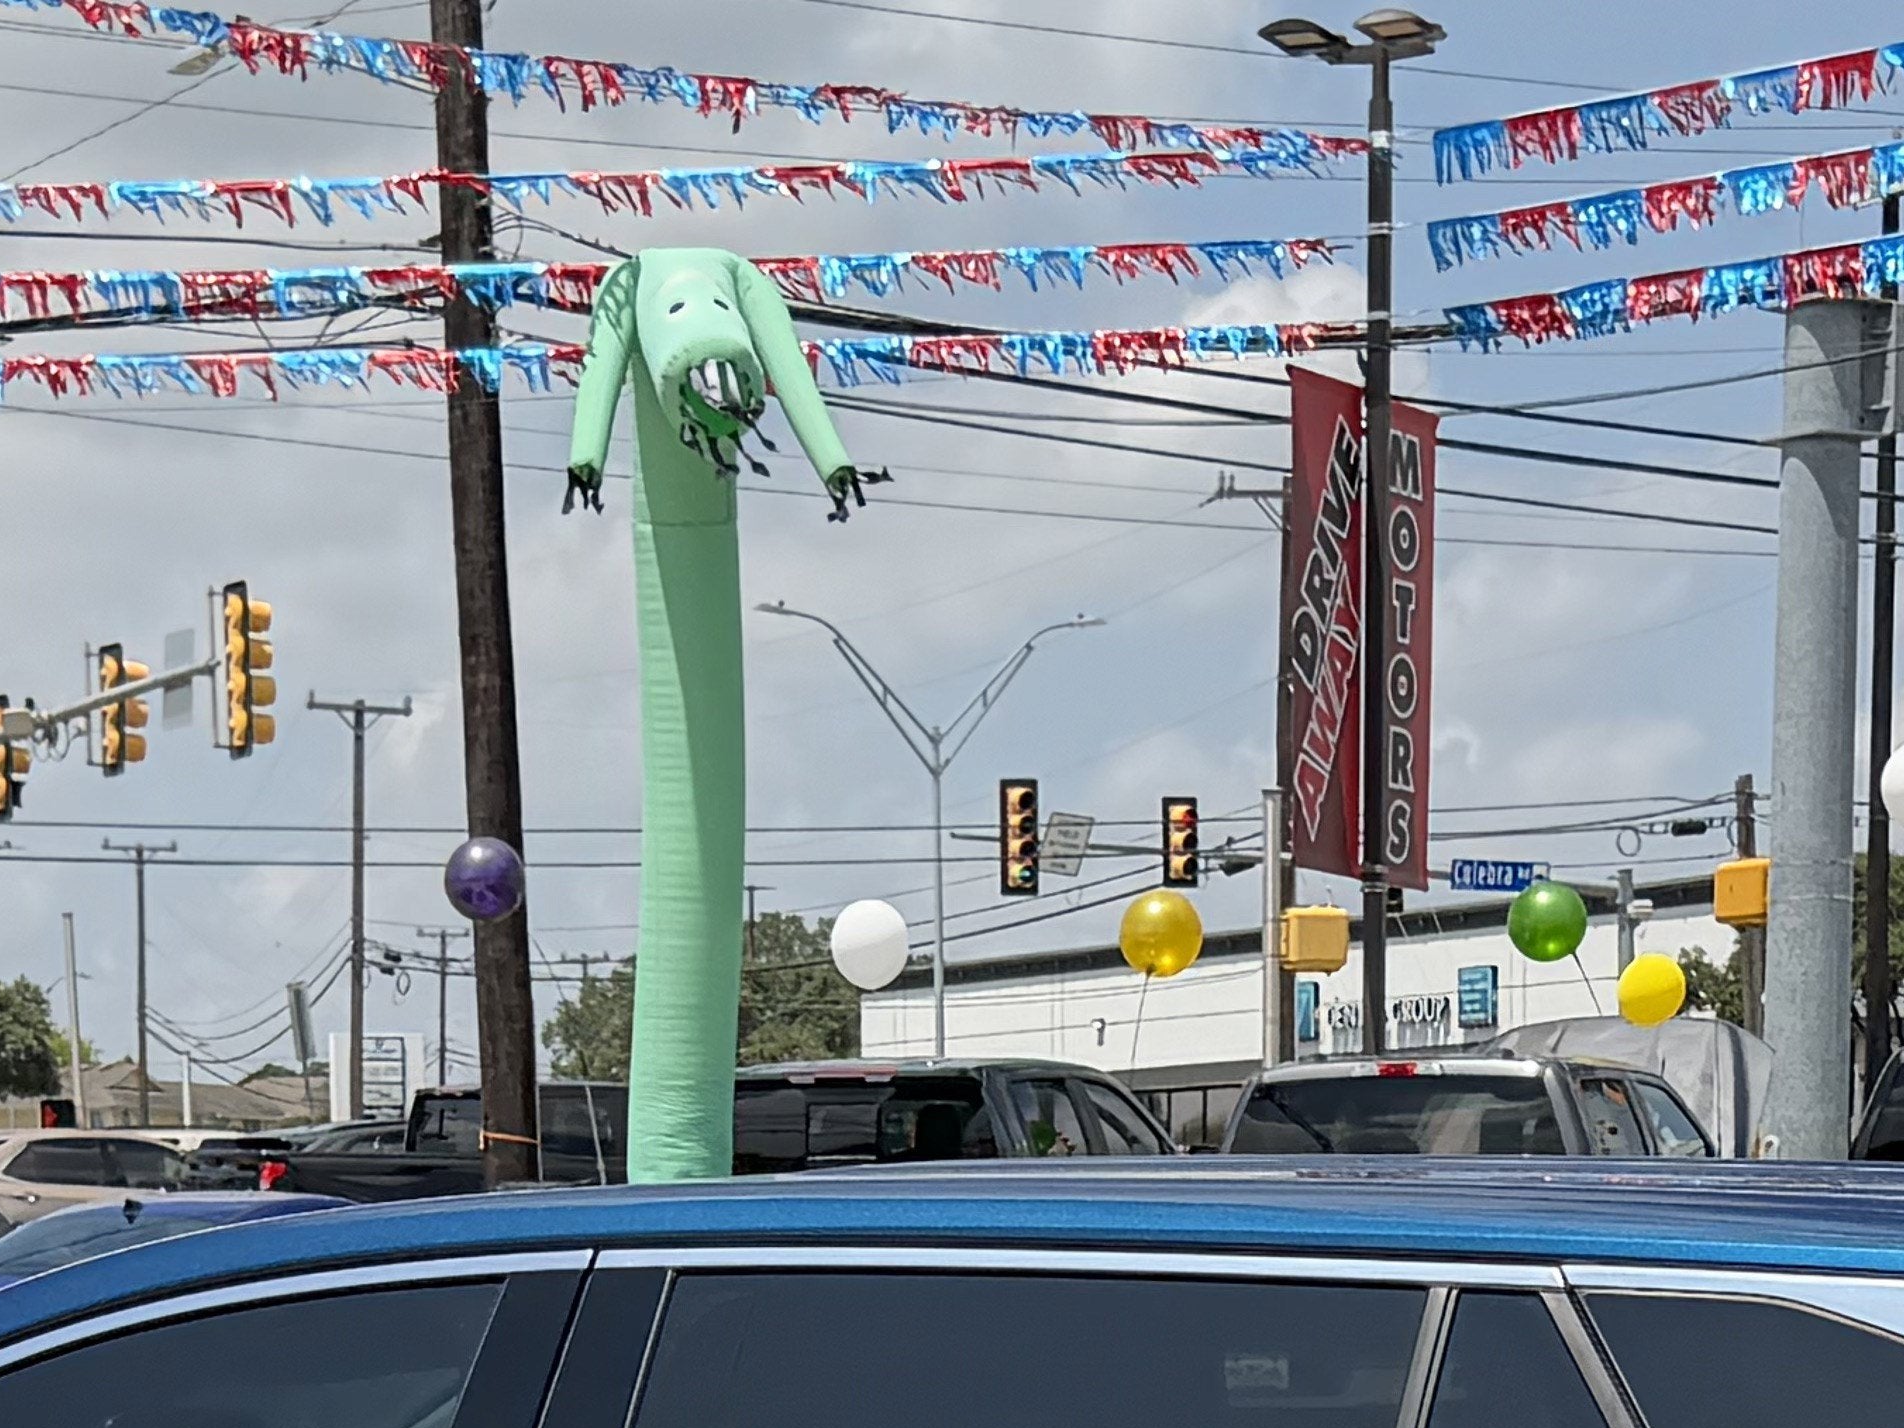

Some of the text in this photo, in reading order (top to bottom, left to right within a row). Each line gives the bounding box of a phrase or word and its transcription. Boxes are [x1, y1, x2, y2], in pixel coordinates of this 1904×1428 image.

[1290, 415, 1362, 694] DRIVE
[1386, 429, 1421, 866] MOTORS
[1293, 562, 1363, 841] AWAY
[1392, 996, 1451, 1024] GROUP
[1455, 862, 1514, 886] Culebra
